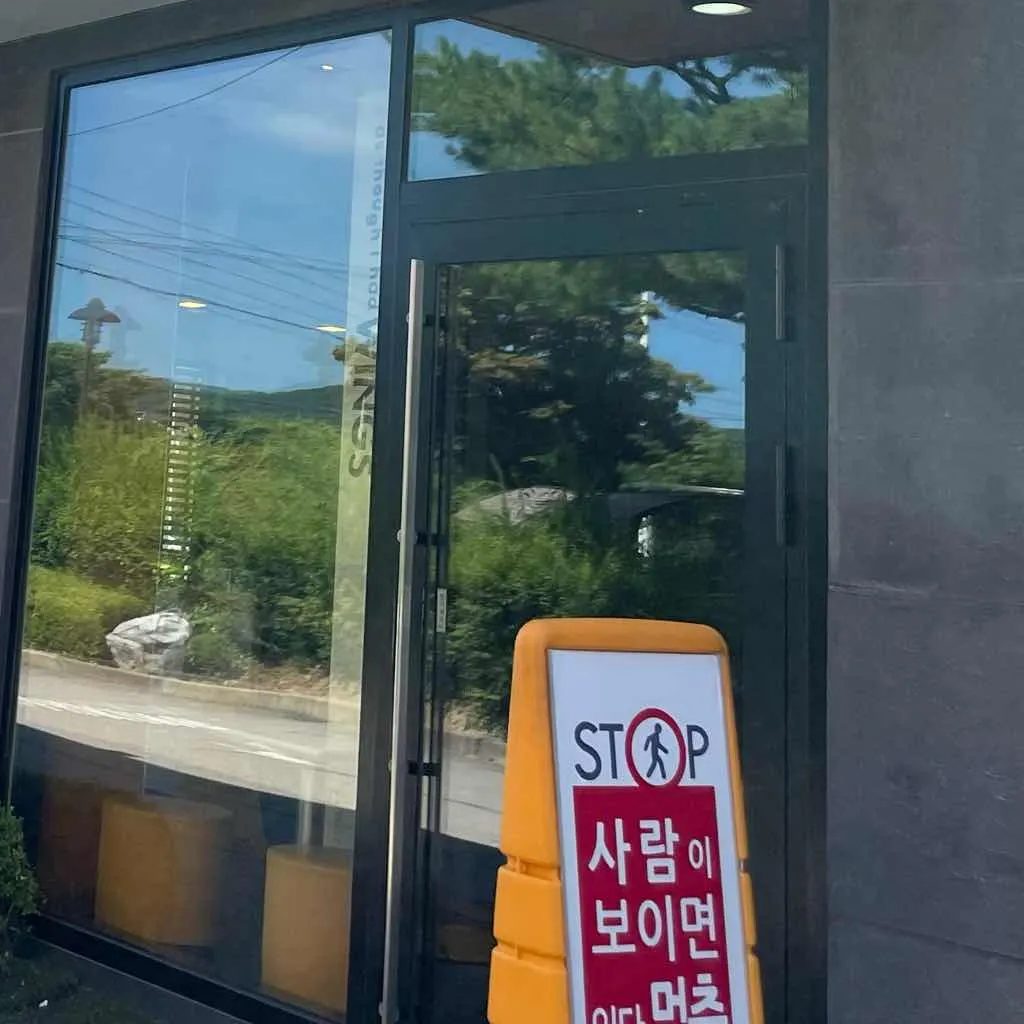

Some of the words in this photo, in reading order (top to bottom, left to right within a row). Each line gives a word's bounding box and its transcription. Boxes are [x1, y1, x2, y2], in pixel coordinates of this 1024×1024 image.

[349, 318, 377, 478] WINGS
[574, 707, 709, 786] STOP
[588, 817, 713, 886] 사람이
[591, 893, 719, 962] 보이면
